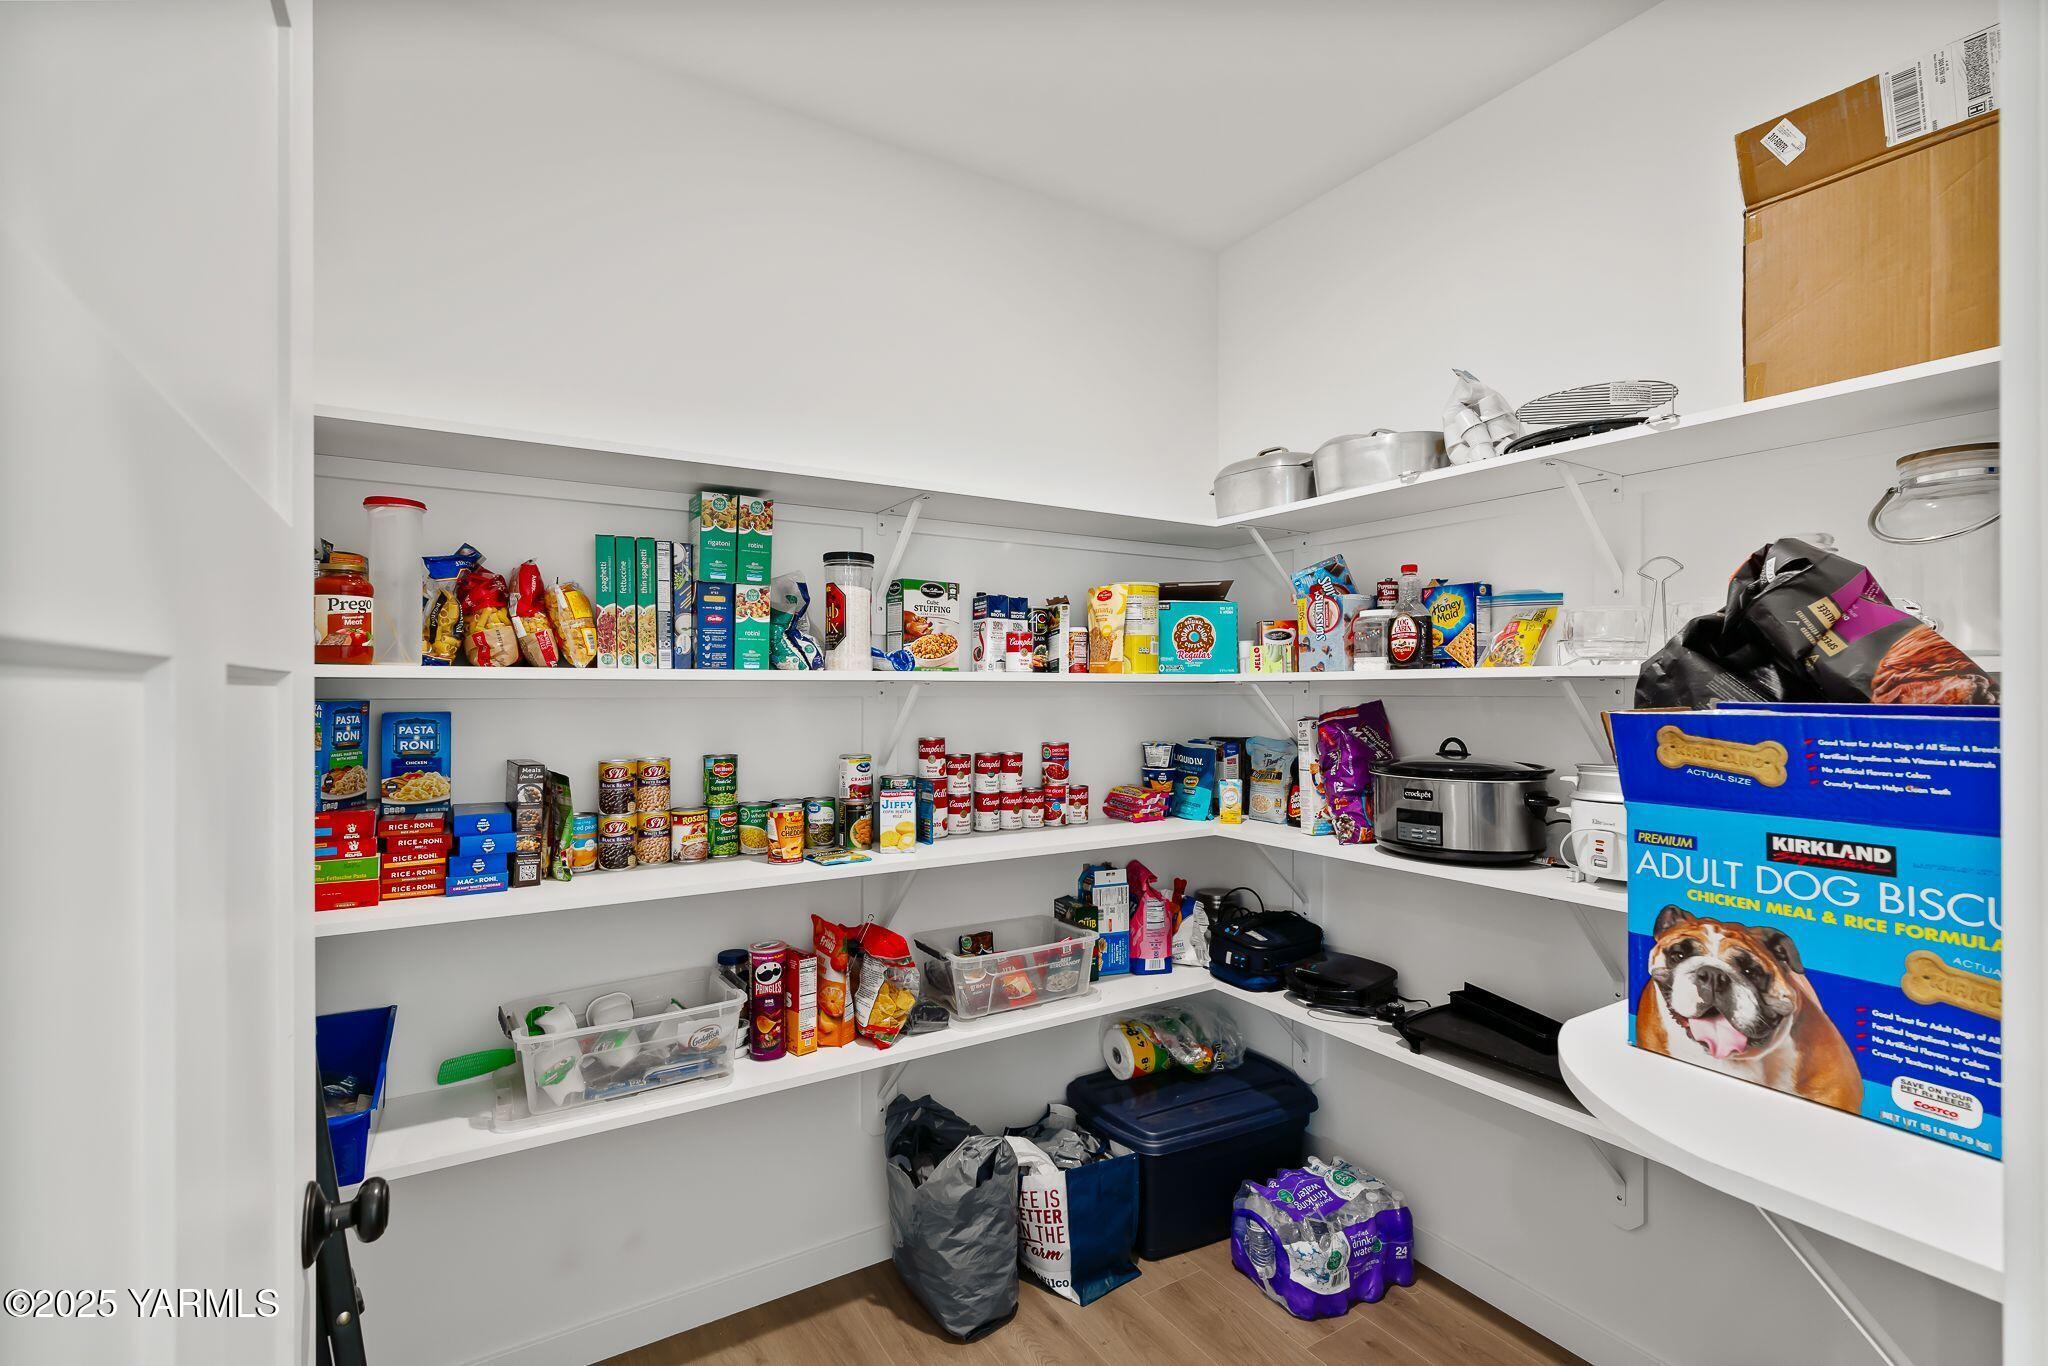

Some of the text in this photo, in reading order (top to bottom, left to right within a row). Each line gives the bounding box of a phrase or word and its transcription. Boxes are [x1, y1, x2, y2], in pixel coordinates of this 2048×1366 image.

[707, 540, 731, 548] rigatoni
[748, 542, 764, 550] rotini
[641, 548, 649, 578] spaghetti
[600, 561, 608, 592] spaghetti
[618, 560, 627, 594] fettuccine
[328, 598, 372, 618] Prego
[914, 605, 951, 614] STUFFING
[1432, 599, 1462, 616] Honey
[1437, 610, 1459, 623] Maid
[1181, 624, 1208, 642] DONUT SHOP
[1177, 650, 1211, 662] Regular
[336, 715, 361, 724] PASTA
[336, 730, 360, 742] RONI
[399, 726, 434, 735] PASTA
[400, 740, 434, 750] RONI
[1174, 753, 1194, 765] LIQUID
[1686, 768, 1752, 786] ACTUAL SIZE
[882, 800, 913, 809] JIFFY
[1638, 832, 1694, 849] PREMIUM
[1772, 836, 1892, 865] KIRKLAND
[457, 877, 474, 885] MAC
[1634, 849, 1860, 907] ADULT DOG
[1686, 888, 1761, 912] CHICKEN
[1766, 900, 1817, 922] MEAL
[1821, 911, 1838, 924] &
[1844, 914, 1888, 933] RICE
[755, 981, 782, 996] PRINGLES
[691, 1029, 721, 1047] Goldfish
[1900, 1078, 1973, 1103] SAVE ON YOUR
[1900, 1085, 1972, 1108] PET NEEDS
[1913, 1100, 1959, 1118] COSTCO
[1903, 1116, 1917, 1128] WT
[1933, 1126, 1946, 1137] LB
[1044, 1190, 1060, 1208] IS
[1294, 1190, 1329, 1210] drinking
[1297, 1183, 1321, 1200] water
[1037, 1226, 1066, 1244] THE
[1395, 1246, 1408, 1256] 24
